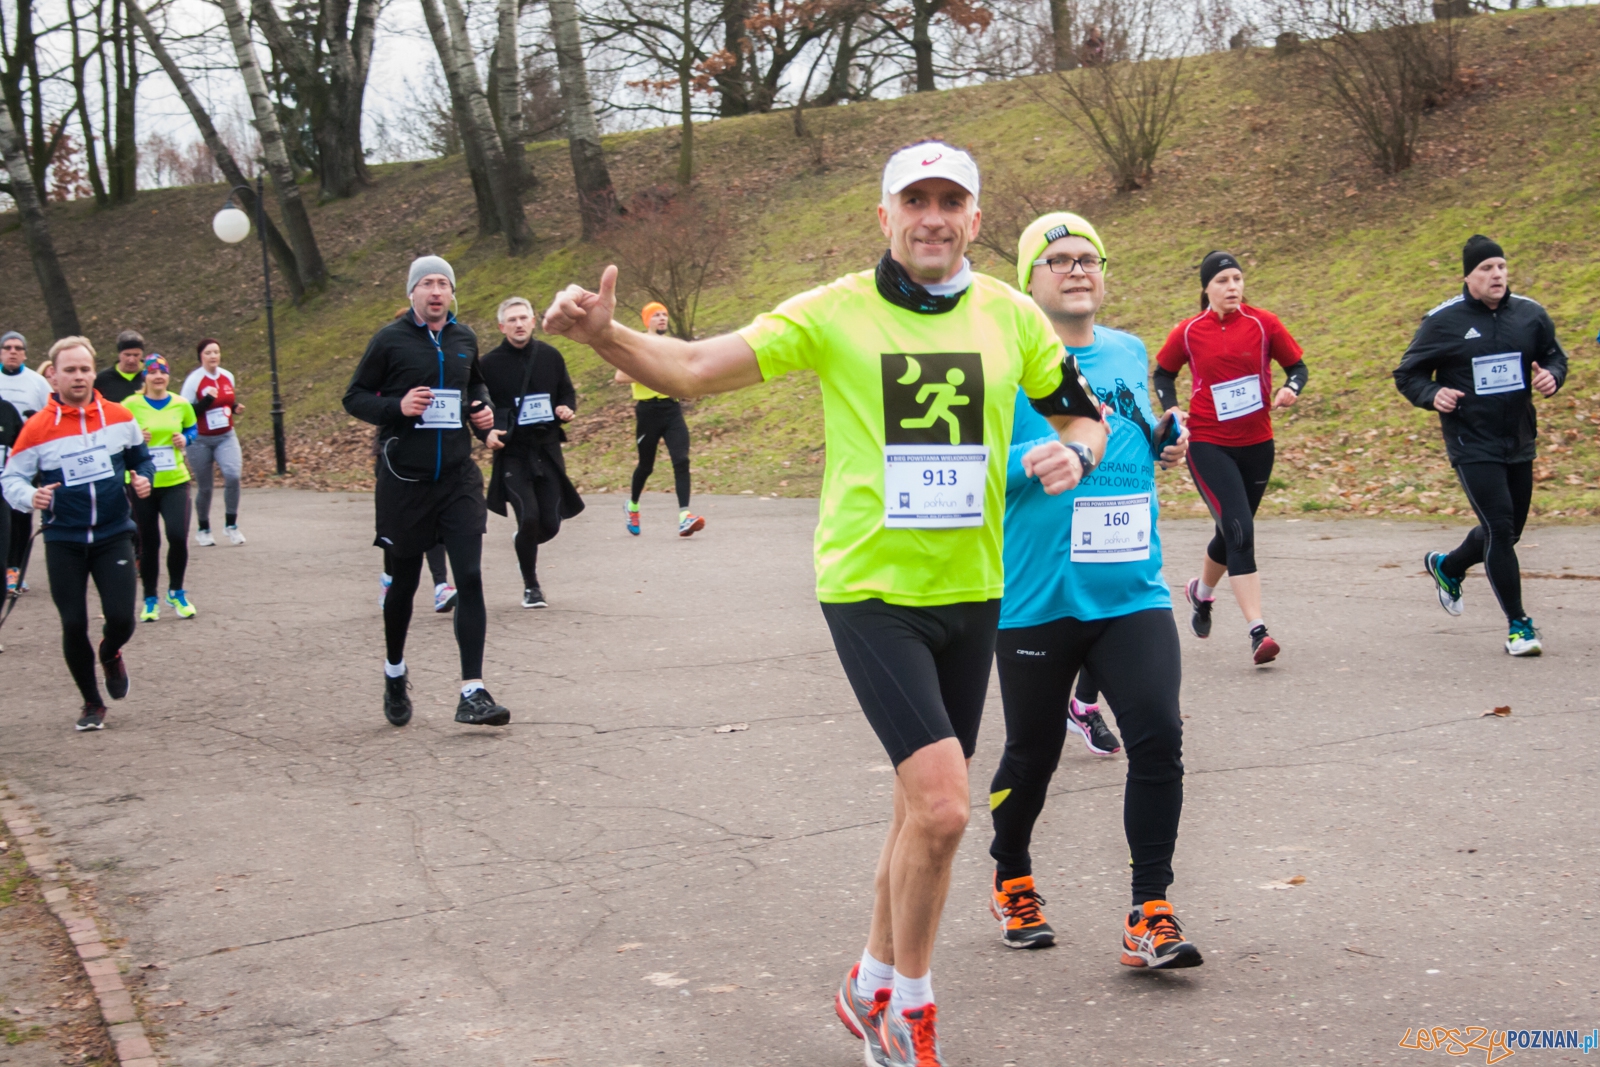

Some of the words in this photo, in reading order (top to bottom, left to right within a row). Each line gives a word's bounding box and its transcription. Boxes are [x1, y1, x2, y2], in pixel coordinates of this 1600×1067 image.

[1491, 364, 1508, 374] 475
[1229, 386, 1247, 399] 782
[429, 400, 446, 409] 715
[77, 455, 95, 466] 588
[1098, 461, 1137, 475] GRAND
[922, 469, 958, 487] 913
[923, 492, 957, 509] parkrun
[1104, 511, 1130, 527] 160
